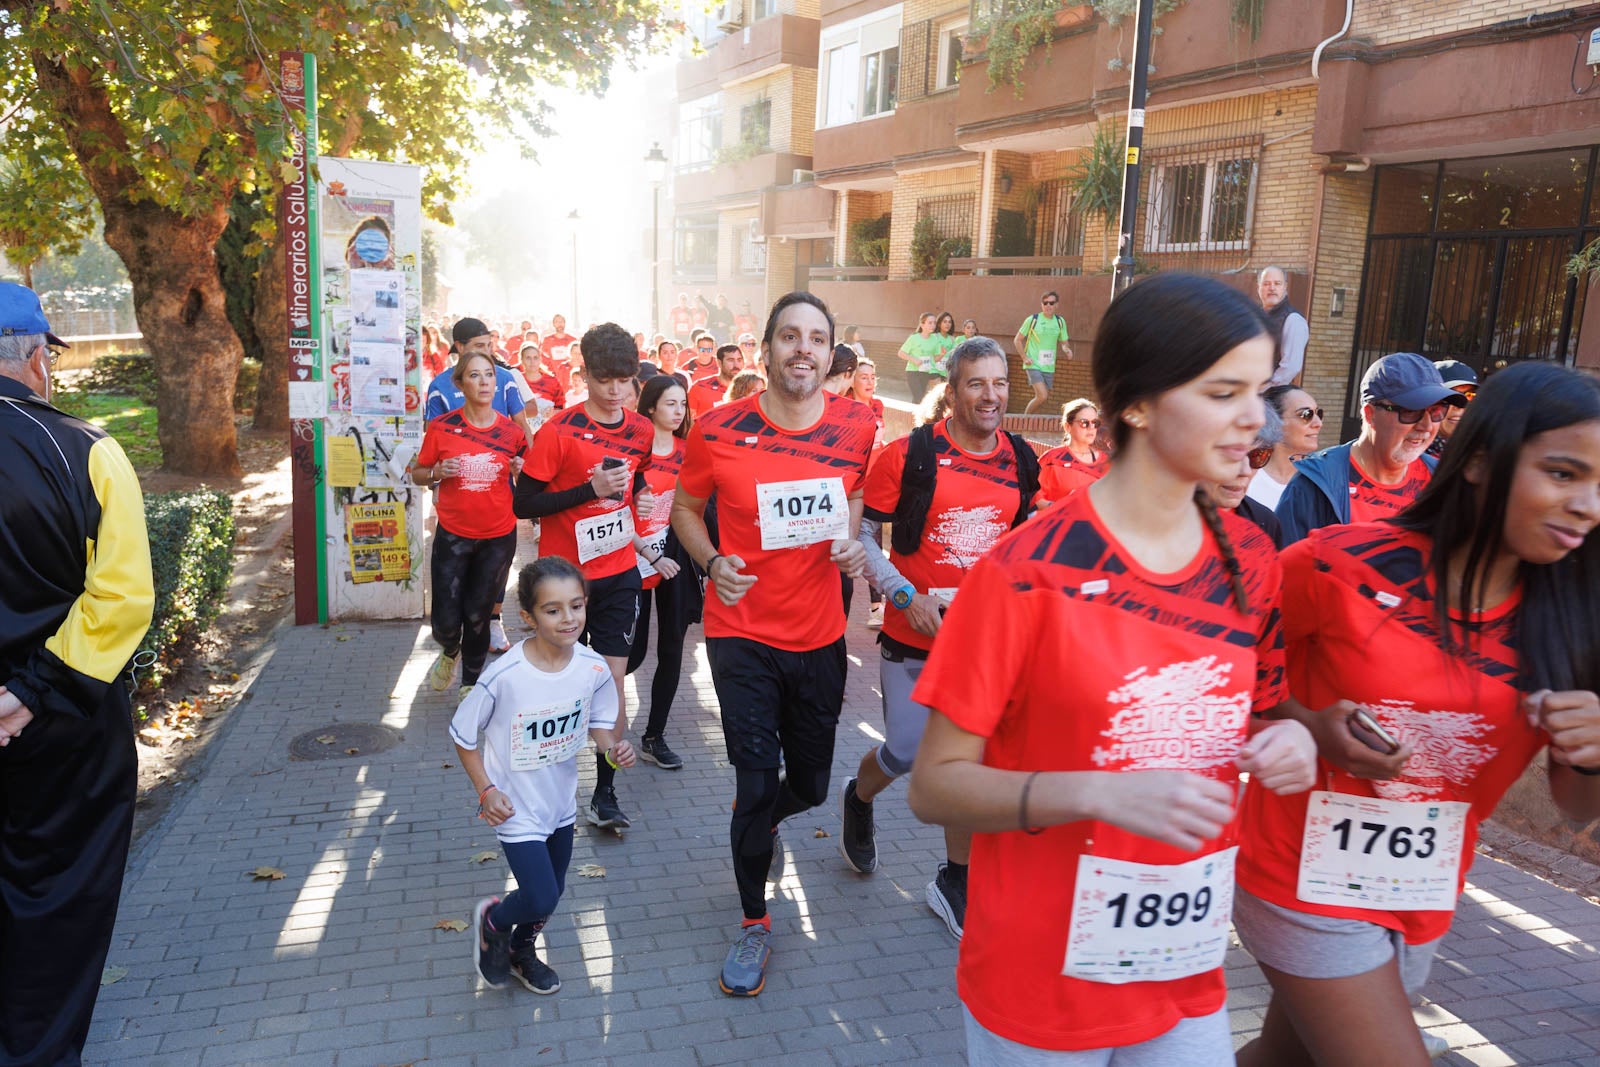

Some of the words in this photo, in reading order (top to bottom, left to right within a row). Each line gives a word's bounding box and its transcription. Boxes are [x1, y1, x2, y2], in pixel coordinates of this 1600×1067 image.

[1500, 207, 1511, 225] 2
[291, 340, 318, 348] MPS
[353, 506, 396, 518] MOLINA
[773, 492, 833, 518] 1074
[587, 519, 624, 541] 1571
[788, 519, 814, 528] ANTONIO
[939, 521, 1001, 537] carrera
[382, 553, 398, 564] 149
[526, 709, 582, 740] 1077
[1110, 702, 1241, 735] carrera
[540, 737, 565, 749] DANIELA
[1384, 727, 1483, 766] arrera
[1332, 818, 1437, 859] 1763
[1106, 886, 1212, 928] 1899
